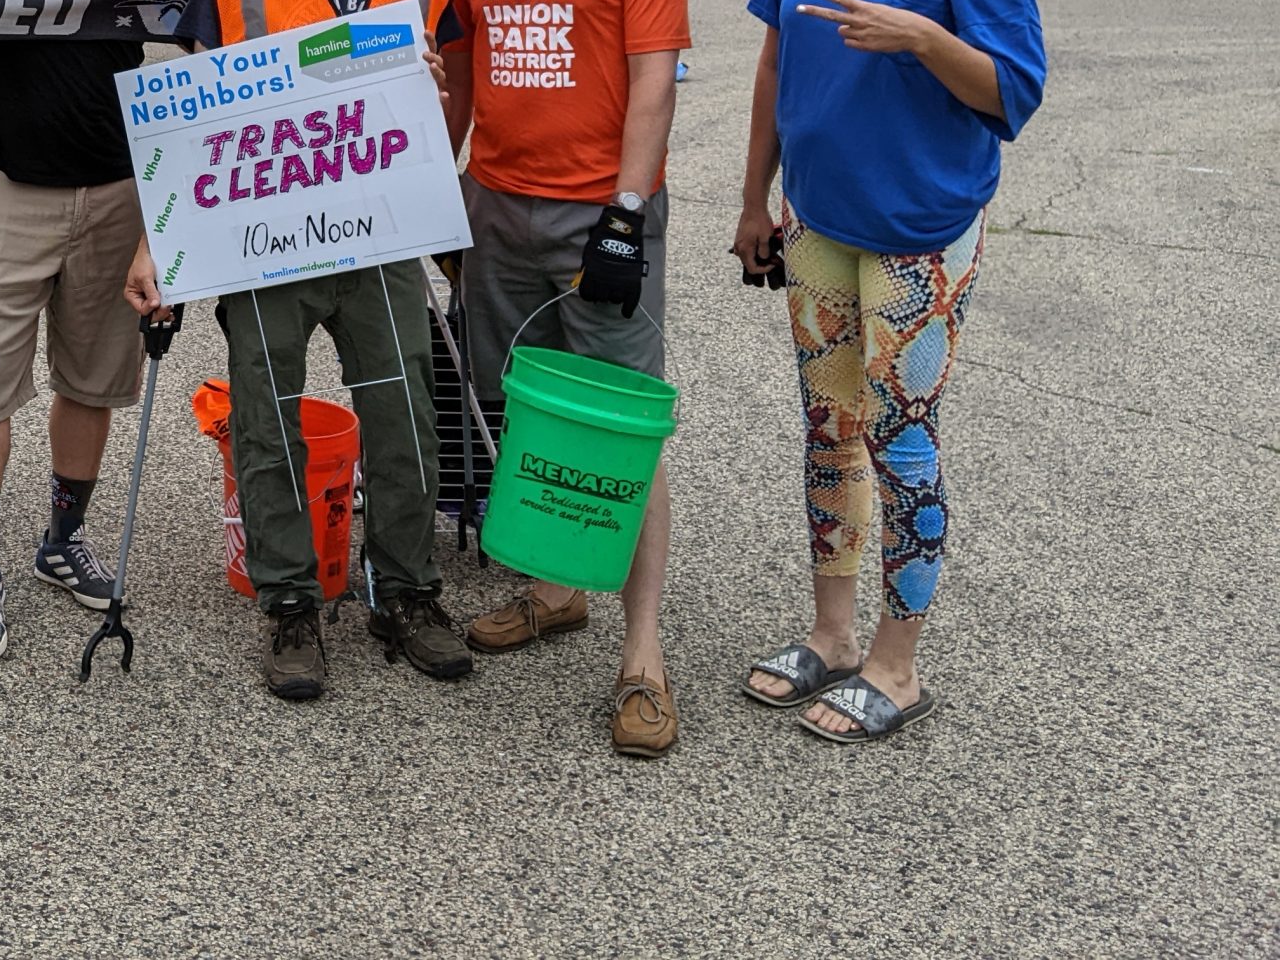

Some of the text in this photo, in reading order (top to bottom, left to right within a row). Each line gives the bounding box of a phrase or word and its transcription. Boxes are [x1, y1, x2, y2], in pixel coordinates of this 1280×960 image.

[482, 3, 574, 25] UNION
[305, 31, 401, 59] hamline midway
[488, 26, 574, 51] PARK
[133, 46, 281, 98] Join Your
[324, 52, 407, 77] COALITION
[491, 52, 576, 69] DISTRICT
[490, 69, 577, 88] COUNCIL
[130, 66, 295, 126] Neighbors!
[203, 99, 365, 166] TRASH
[142, 147, 163, 182] What
[193, 128, 409, 209] CLEANUP
[153, 192, 177, 234] Where
[163, 249, 186, 287] When
[262, 255, 356, 281] hamlinemidway.org
[521, 452, 644, 499] MENARDS
[520, 497, 556, 515] service
[558, 510, 583, 523] and
[541, 489, 612, 517] Dedicated to
[821, 690, 867, 721] adidas
